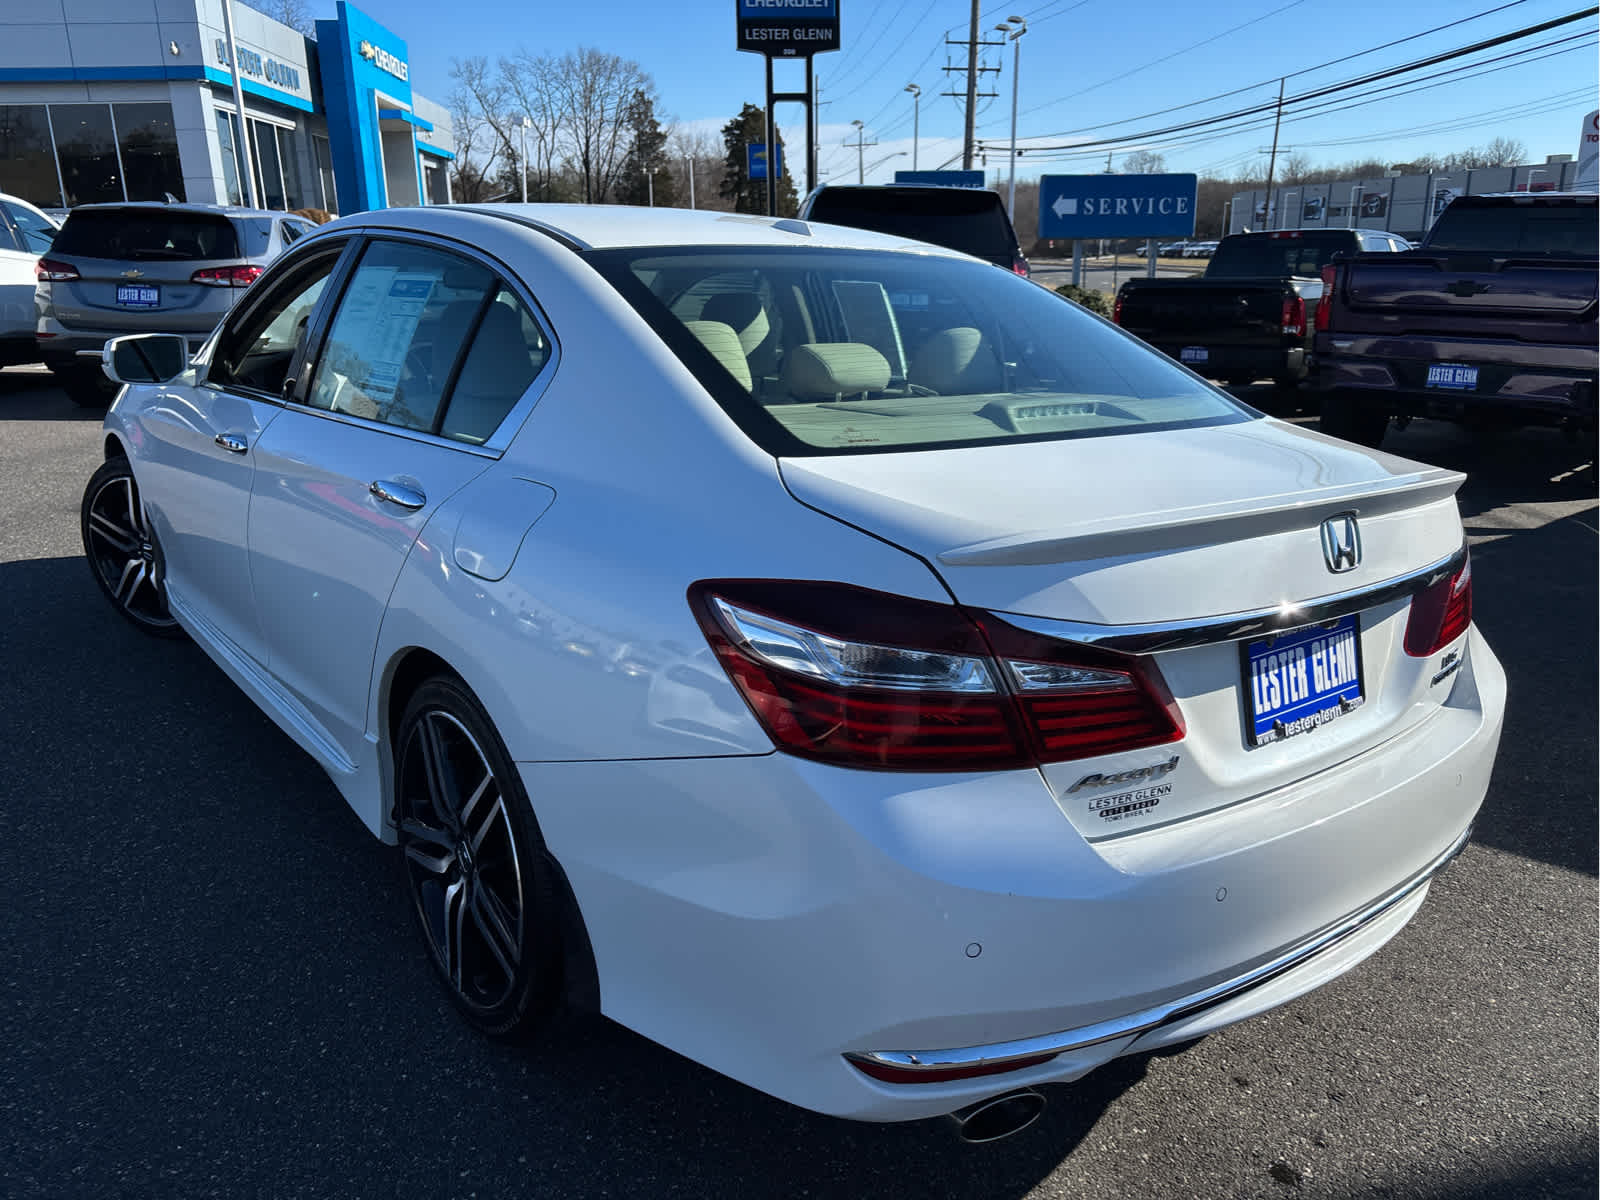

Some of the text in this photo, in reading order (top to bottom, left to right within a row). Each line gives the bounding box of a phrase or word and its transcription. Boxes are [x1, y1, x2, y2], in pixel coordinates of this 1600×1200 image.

[745, 28, 833, 40] LESTER GLENN
[1083, 196, 1188, 215] SERVICE
[118, 287, 158, 302] LESTER GLENN
[1428, 367, 1478, 383] LESTER GLENN
[1251, 647, 1309, 715] LESTER
[1311, 631, 1357, 694] GLENN
[1064, 755, 1180, 793] Accord
[1088, 785, 1172, 809] LESTER GLENN
[1102, 799, 1158, 817] AUTO GROUP
